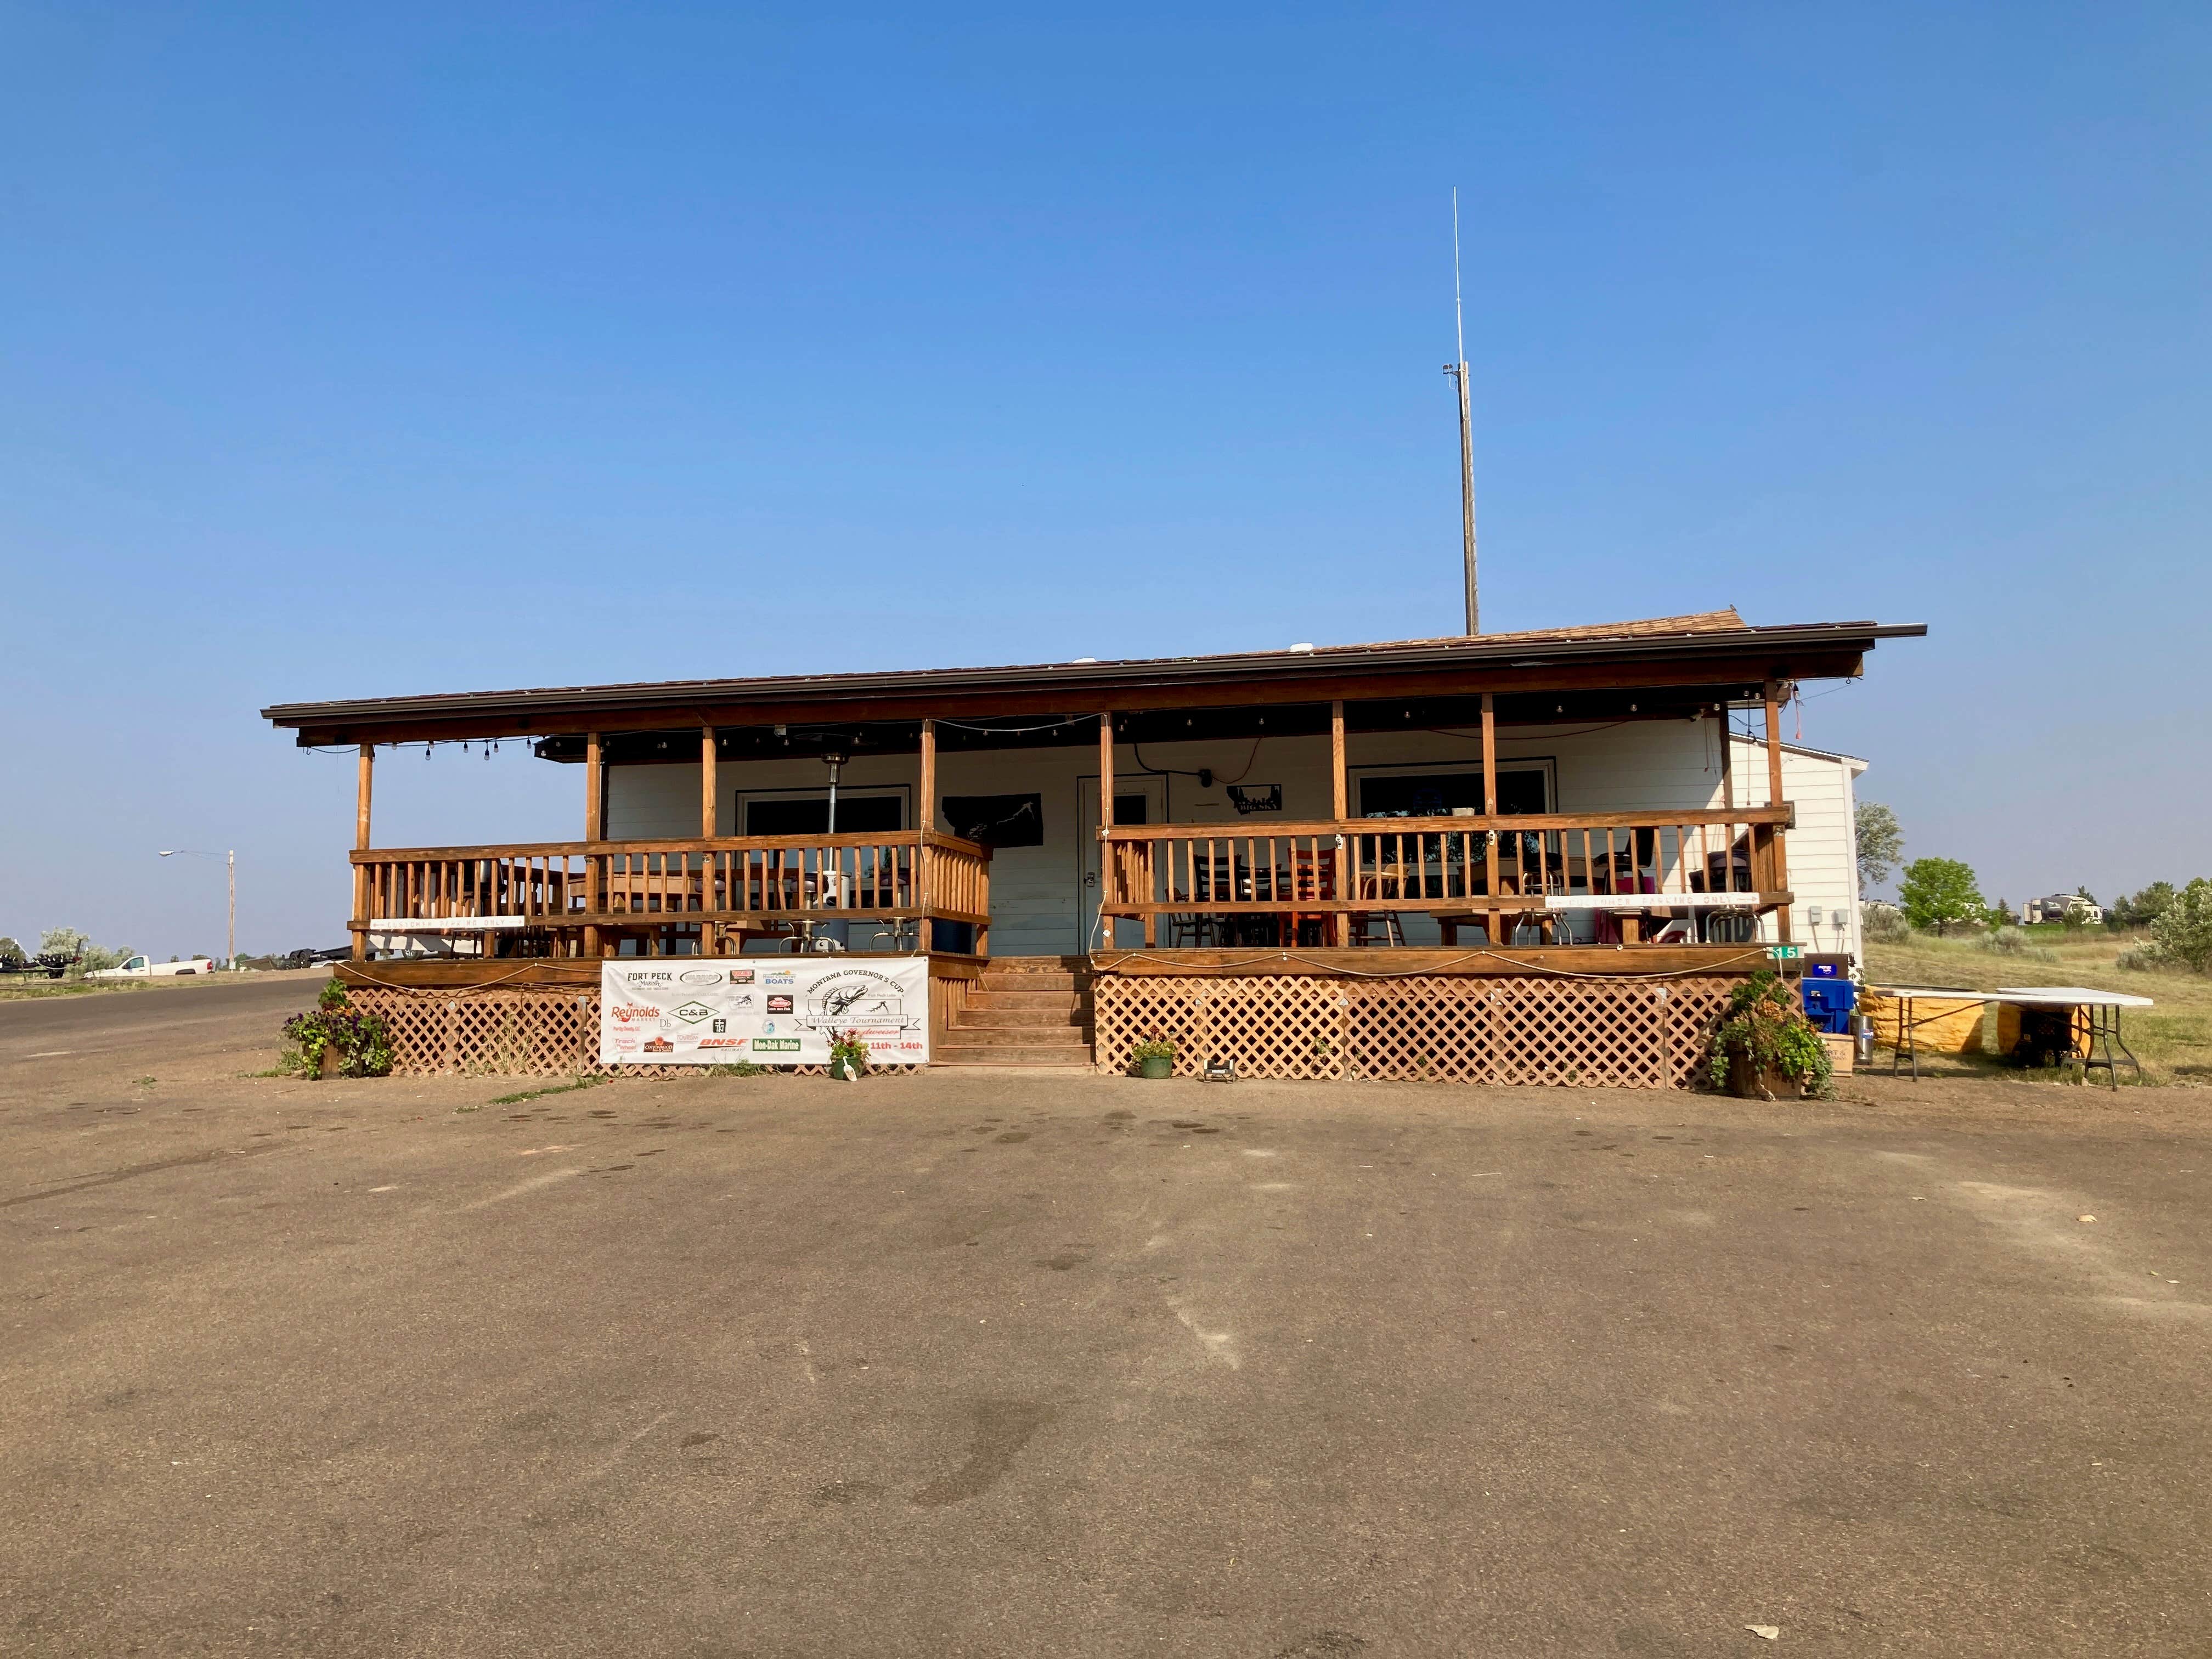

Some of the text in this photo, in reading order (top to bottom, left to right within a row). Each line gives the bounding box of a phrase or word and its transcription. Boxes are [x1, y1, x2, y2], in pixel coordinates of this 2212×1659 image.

[628, 973, 672, 981] FORT PECK
[806, 969, 905, 994] MONTANA GOVERNOR'S CUP
[611, 1005, 660, 1022] Reynolds
[811, 1017, 848, 1025] Walleye
[754, 1040, 799, 1050] Mon-Dak Marine
